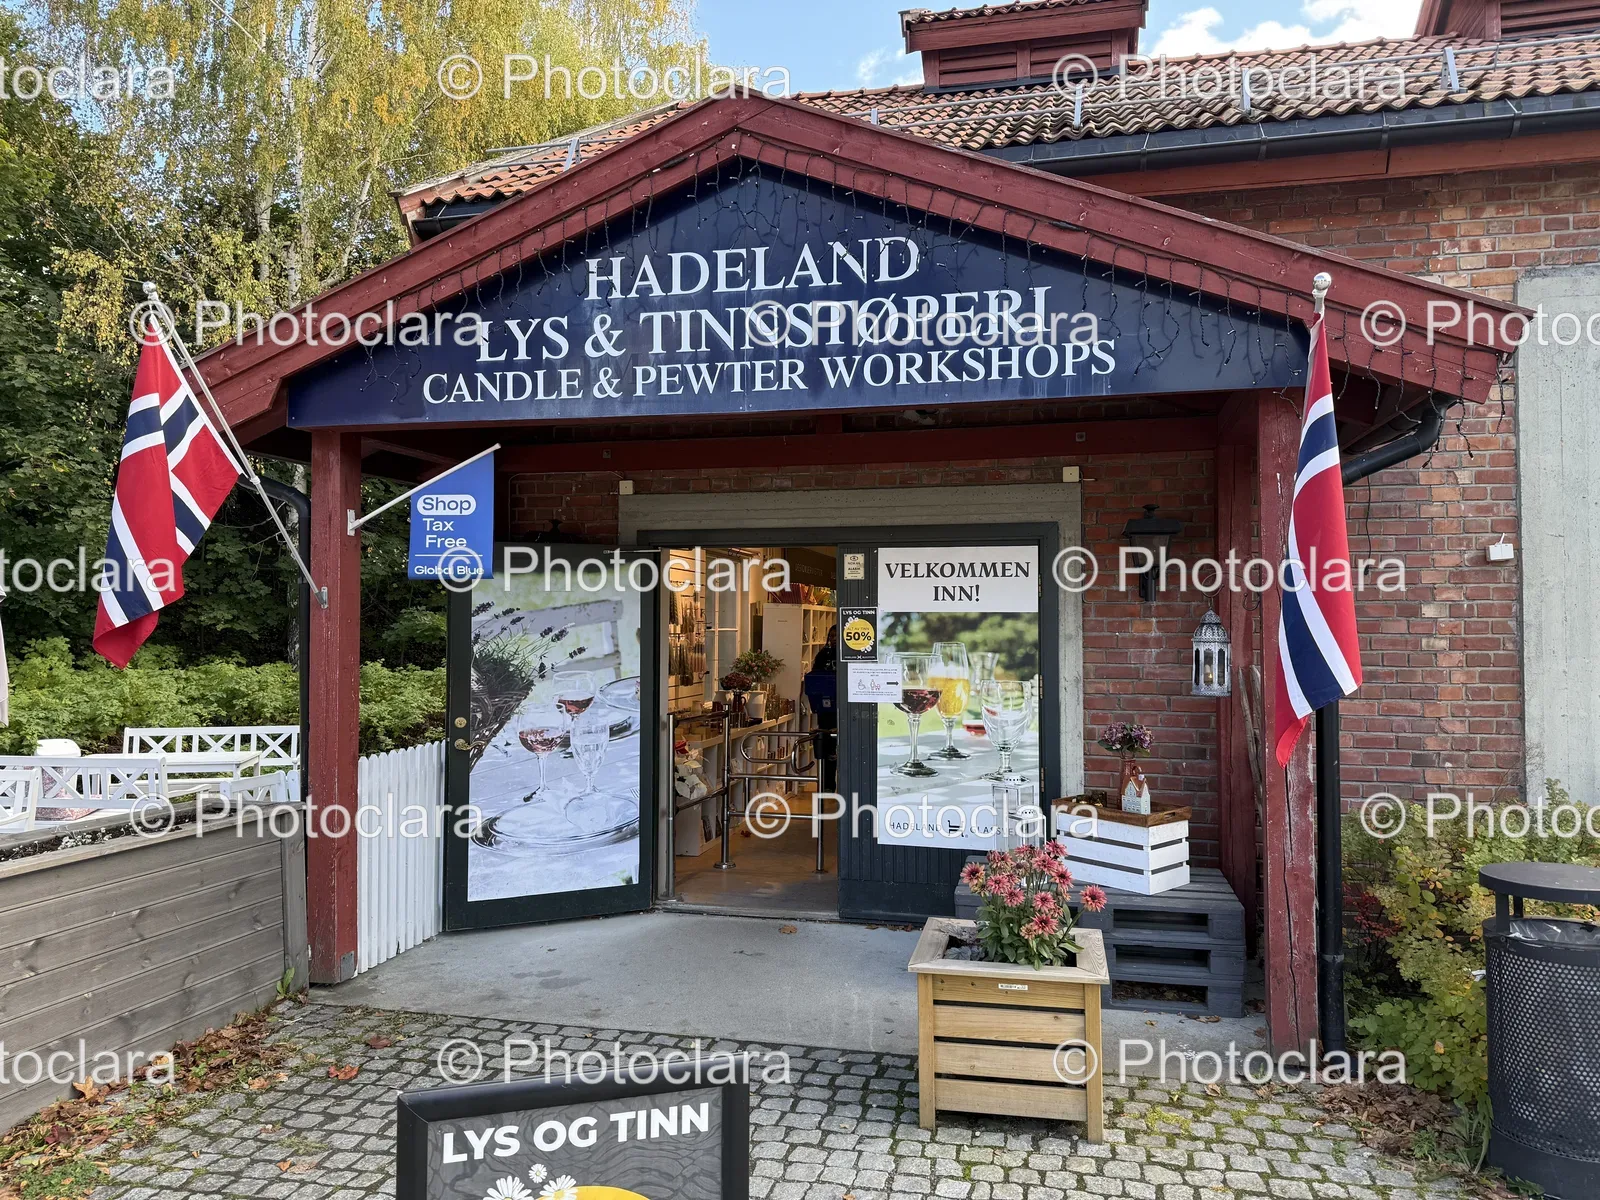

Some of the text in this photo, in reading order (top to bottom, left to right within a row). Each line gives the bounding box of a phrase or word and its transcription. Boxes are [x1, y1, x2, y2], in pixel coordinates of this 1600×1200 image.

[584, 237, 920, 300] HADELAND
[476, 286, 1052, 362] LYS & TINNSTØPERI
[423, 368, 584, 404] CANDLE
[592, 366, 623, 399] &
[633, 359, 808, 397] PEWTER
[820, 339, 1116, 389] WORKSHOPS
[422, 496, 472, 514] Shop
[422, 518, 454, 531] Tax
[425, 535, 467, 548] Free
[457, 565, 484, 575] Blue
[885, 561, 1031, 579] VELKOMMEN
[933, 584, 980, 602] INN!
[846, 631, 872, 641] 50%
[442, 1102, 709, 1164] LYS OG TINN
